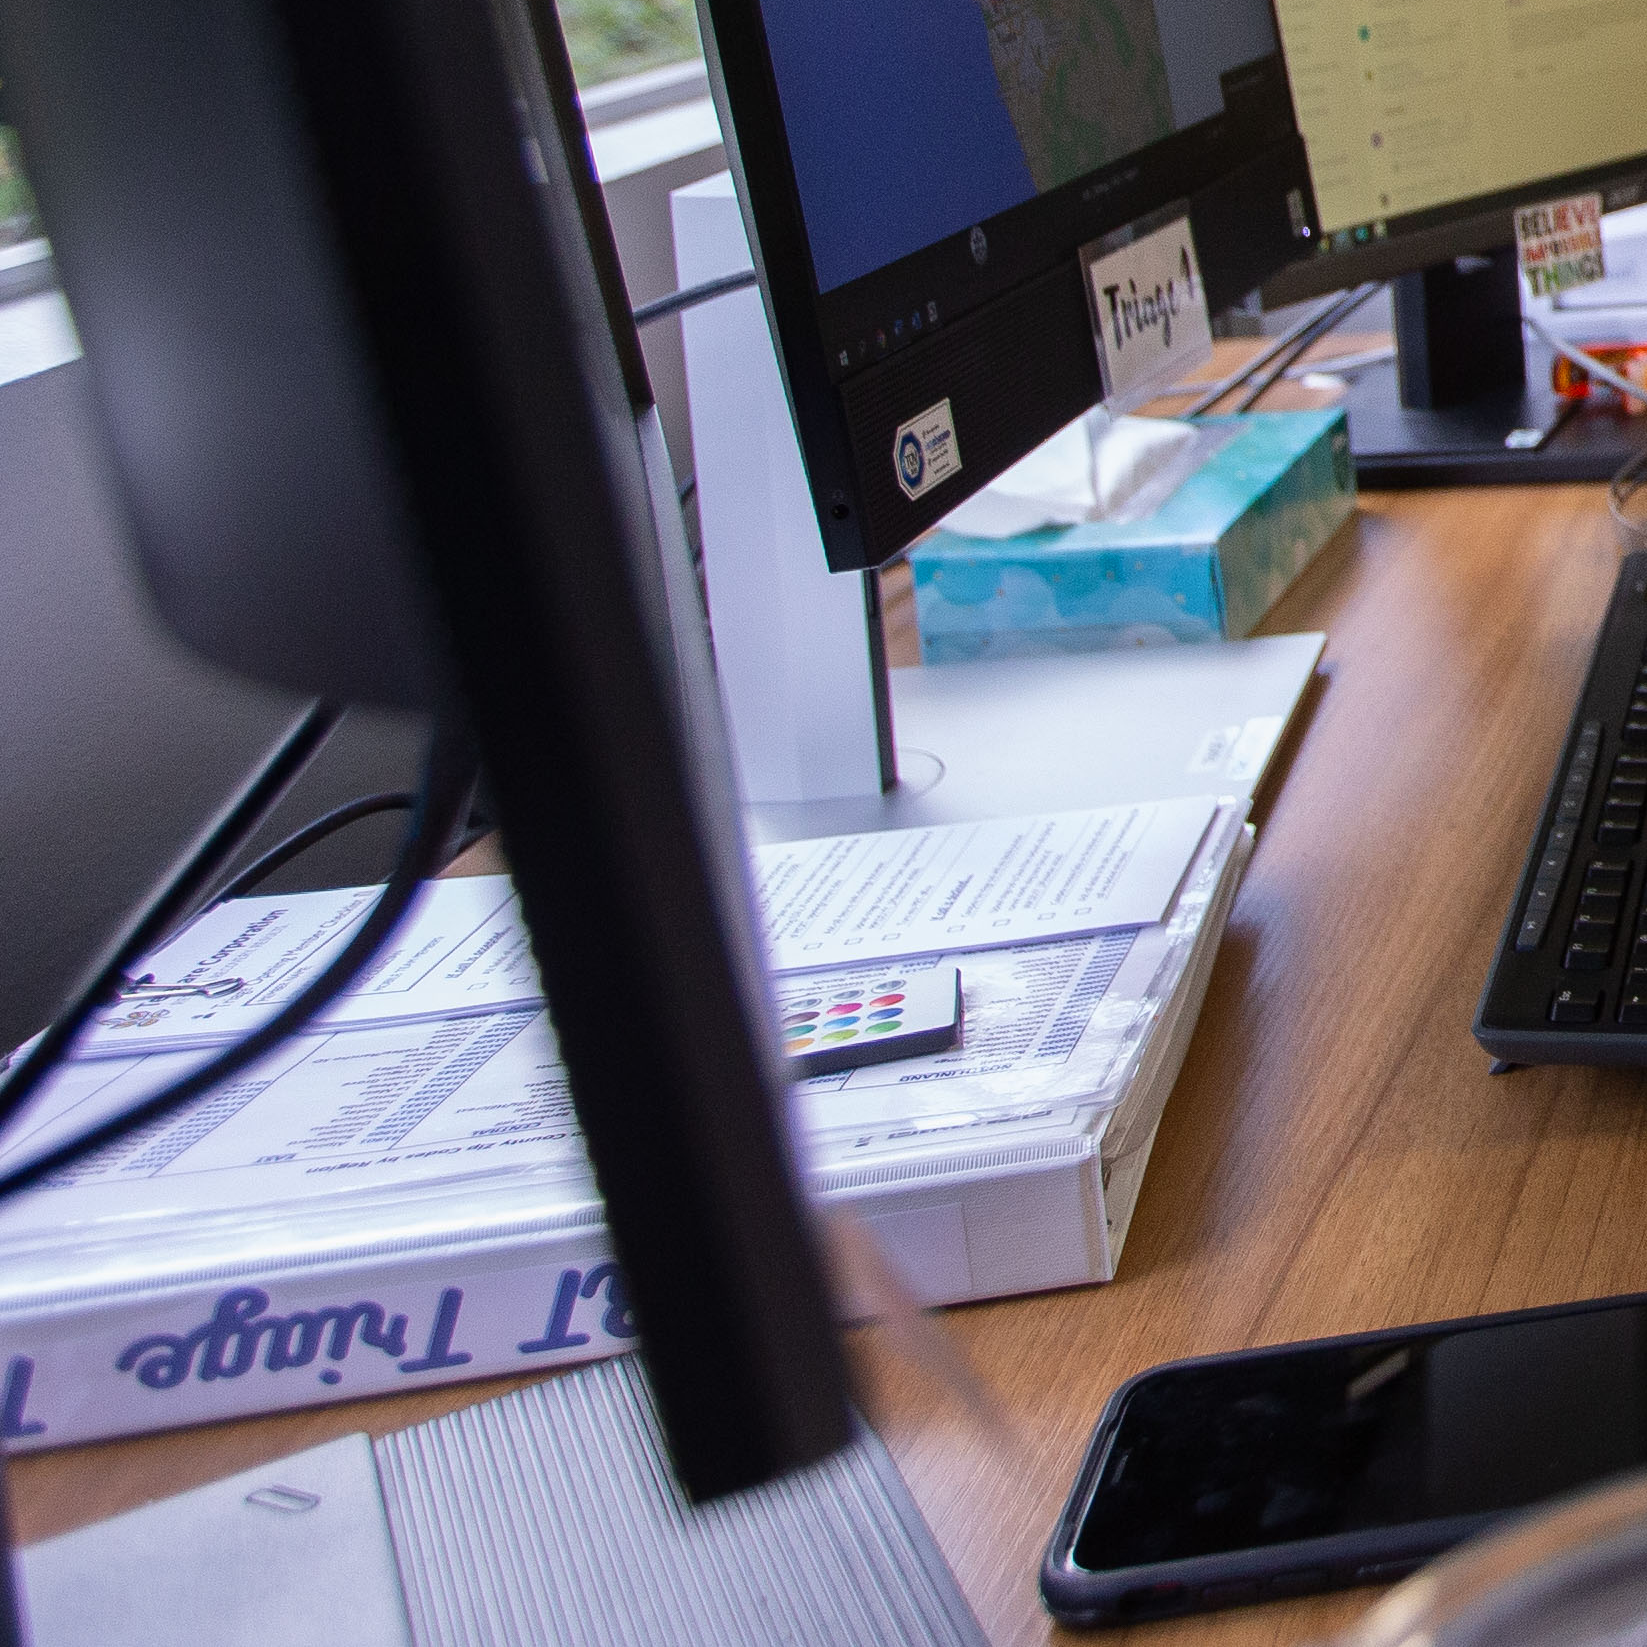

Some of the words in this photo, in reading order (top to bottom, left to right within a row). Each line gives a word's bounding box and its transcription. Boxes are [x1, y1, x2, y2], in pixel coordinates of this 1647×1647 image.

[1101, 276, 1179, 351] Triage
[211, 908, 289, 969] Corporation
[898, 1069, 958, 1082] INLAND
[466, 1141, 495, 1151] Zip
[499, 1132, 565, 1146] County
[377, 1155, 399, 1164] by
[407, 1146, 461, 1159] Codes
[306, 1159, 371, 1174] Region
[114, 1284, 474, 1388] Triage
